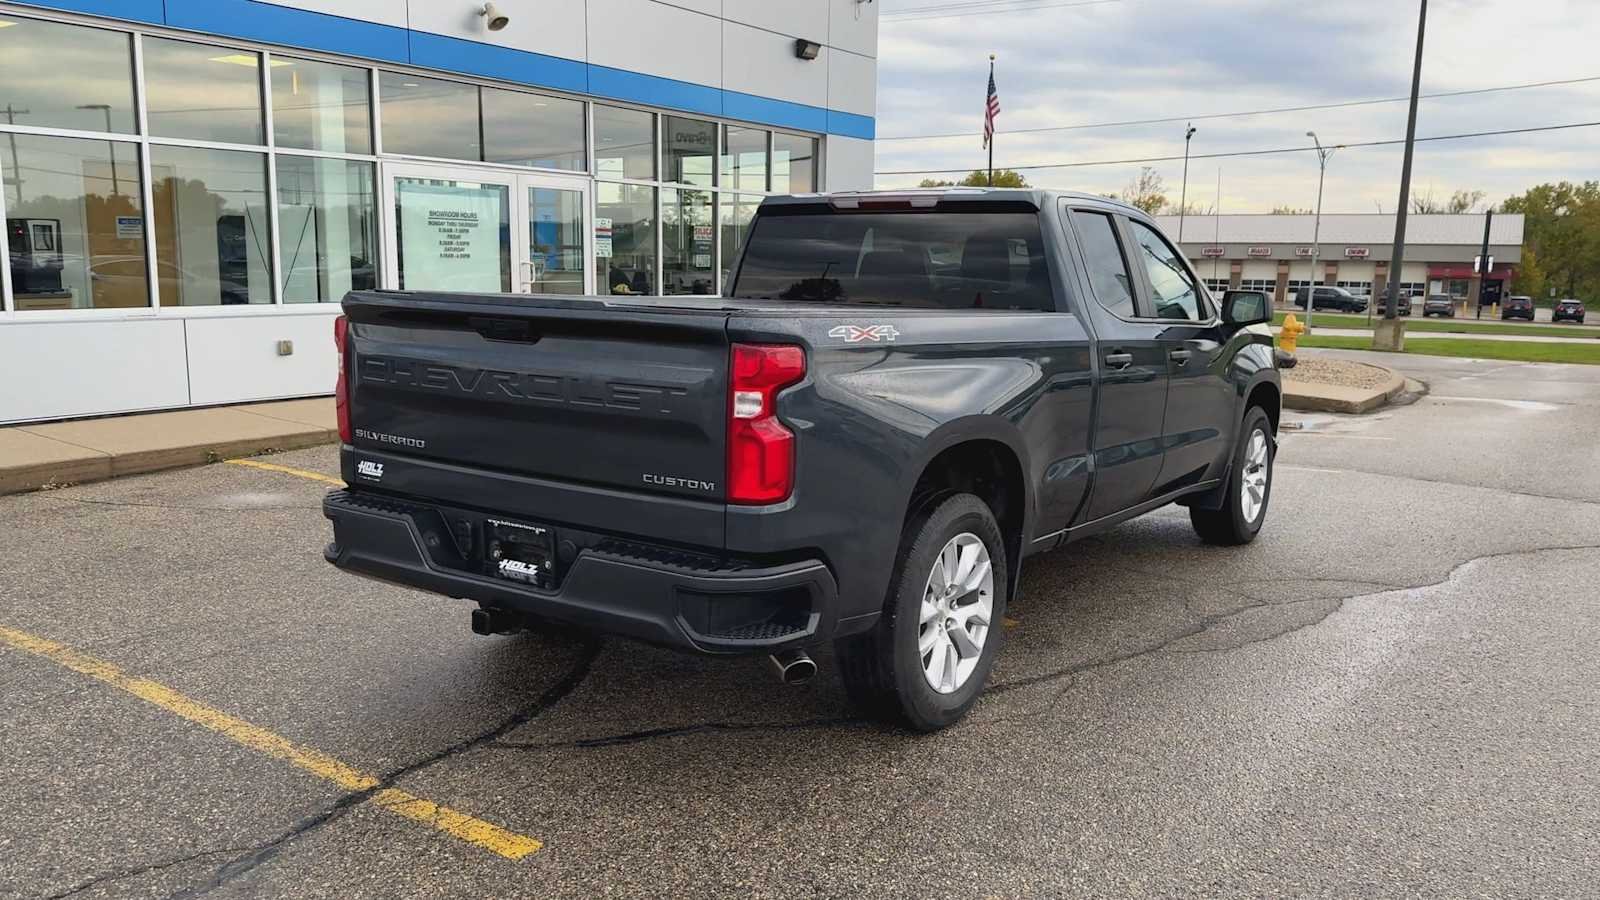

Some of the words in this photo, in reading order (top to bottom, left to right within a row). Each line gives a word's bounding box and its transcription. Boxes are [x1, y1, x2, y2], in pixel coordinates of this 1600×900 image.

[362, 357, 688, 413] CHEVROLET
[355, 428, 425, 448] SILVERADO
[357, 460, 384, 476] HOLZ
[643, 474, 715, 491] CUSTOM
[498, 558, 539, 575] HOLZ
